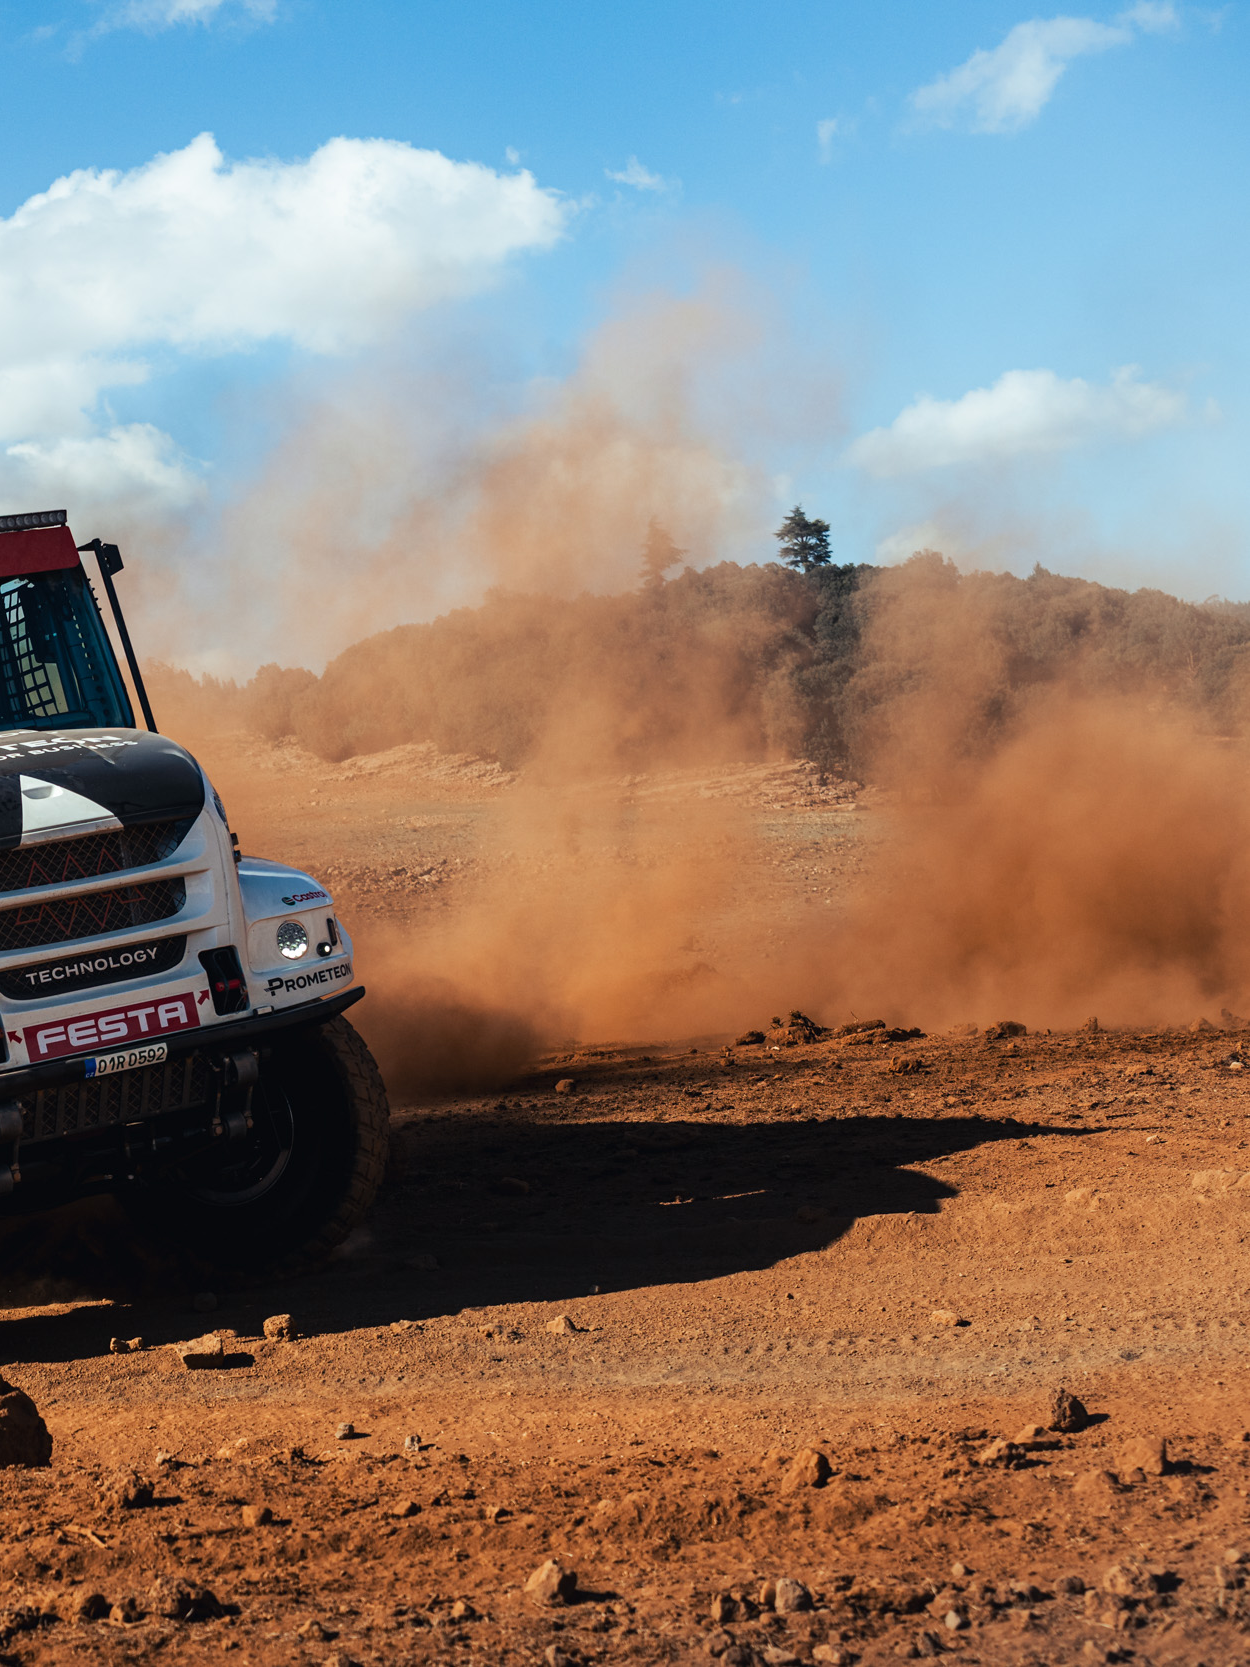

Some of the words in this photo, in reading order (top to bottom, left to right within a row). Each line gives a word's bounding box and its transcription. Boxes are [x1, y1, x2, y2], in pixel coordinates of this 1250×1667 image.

[292, 890, 326, 903] Castrol
[25, 946, 158, 986] TECHNOLOGY
[264, 963, 352, 997] PROMETEON
[36, 1000, 188, 1054] FESTA
[128, 1045, 166, 1066] 0592
